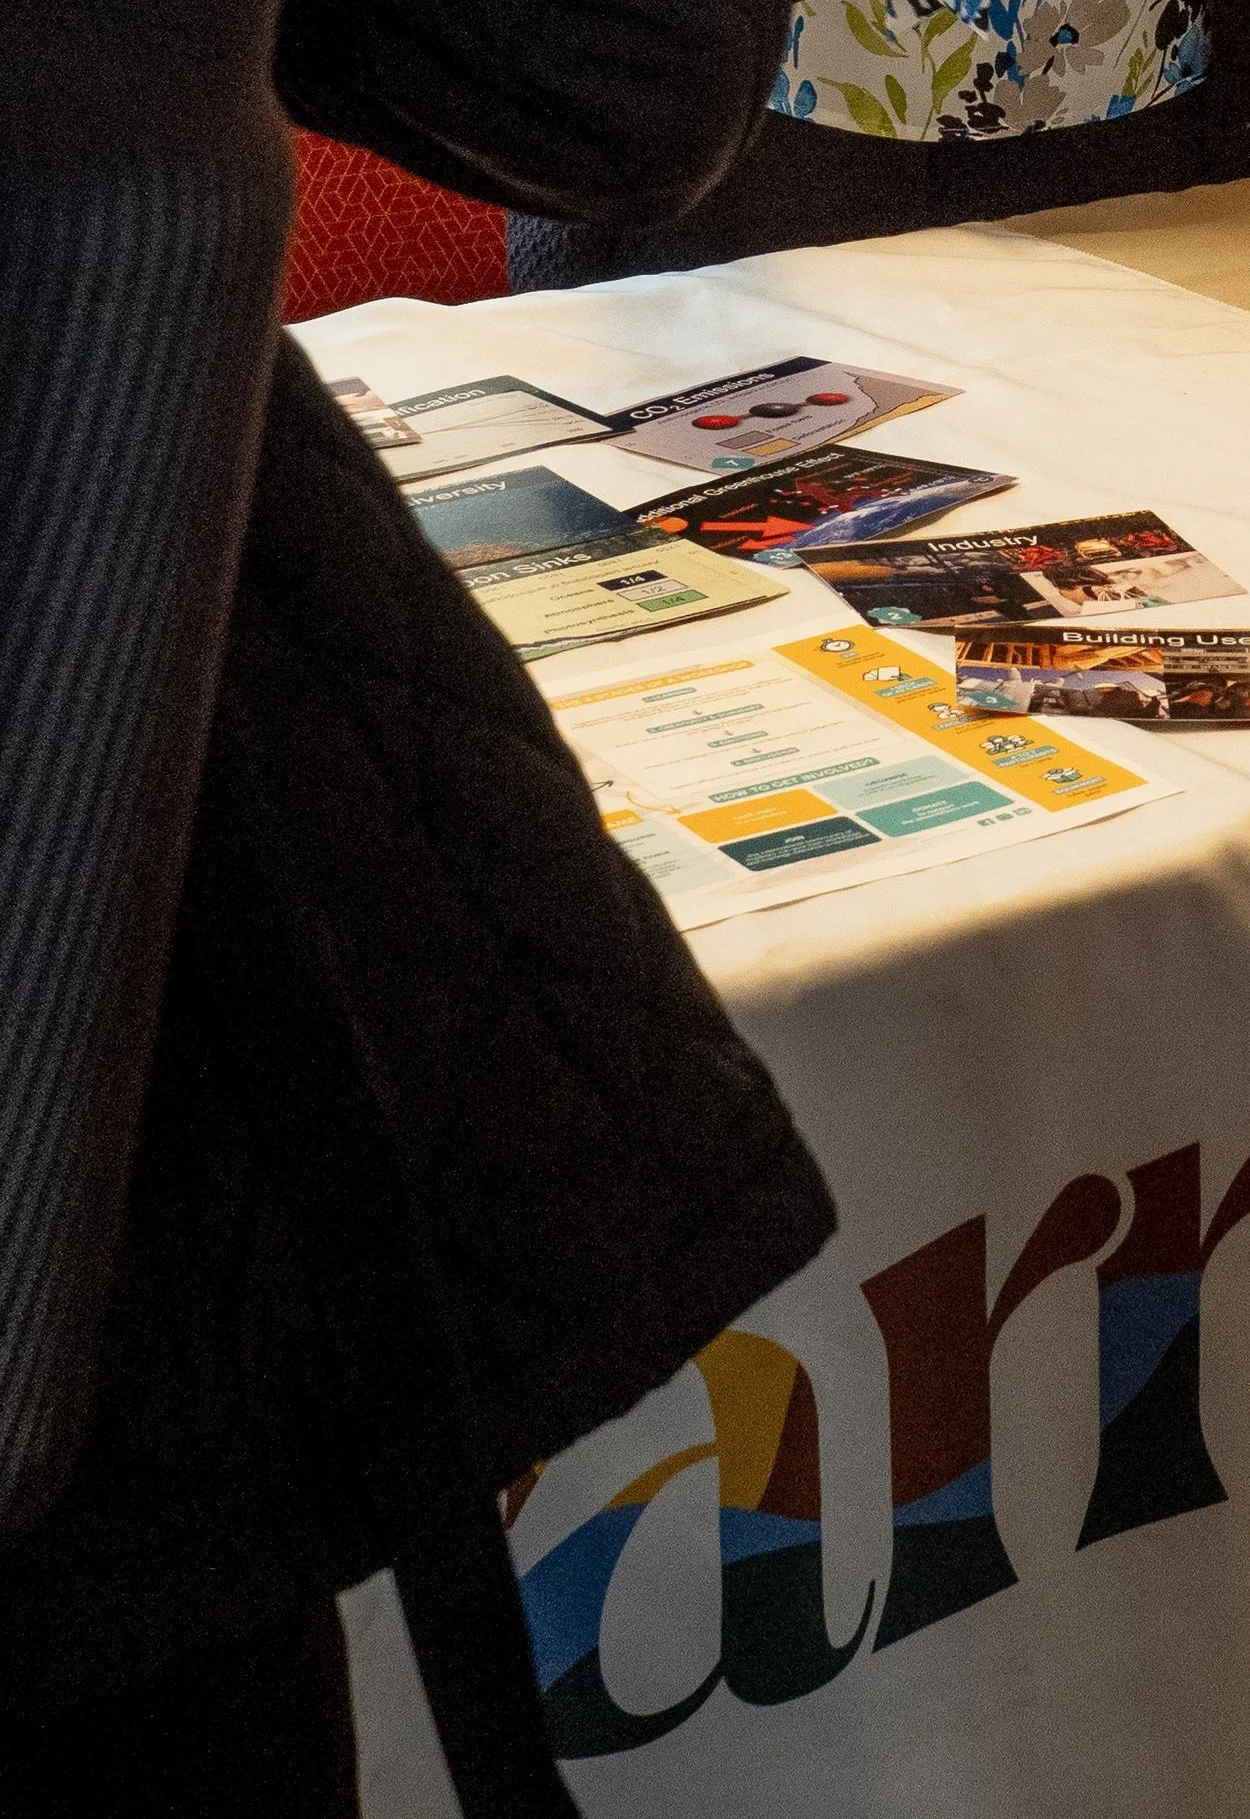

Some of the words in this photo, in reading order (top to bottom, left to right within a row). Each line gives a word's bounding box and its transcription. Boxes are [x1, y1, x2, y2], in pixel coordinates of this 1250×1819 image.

[672, 373, 776, 406] Emissions
[703, 464, 800, 497] Greenhouse
[797, 451, 845, 469] Effect
[928, 534, 1038, 554] Industry
[513, 552, 592, 574] Sinks
[641, 585, 667, 595] 1/2
[1062, 631, 1185, 647] Building
[714, 789, 749, 803] HOW
[751, 783, 769, 794] TO
[772, 776, 800, 789] GET
